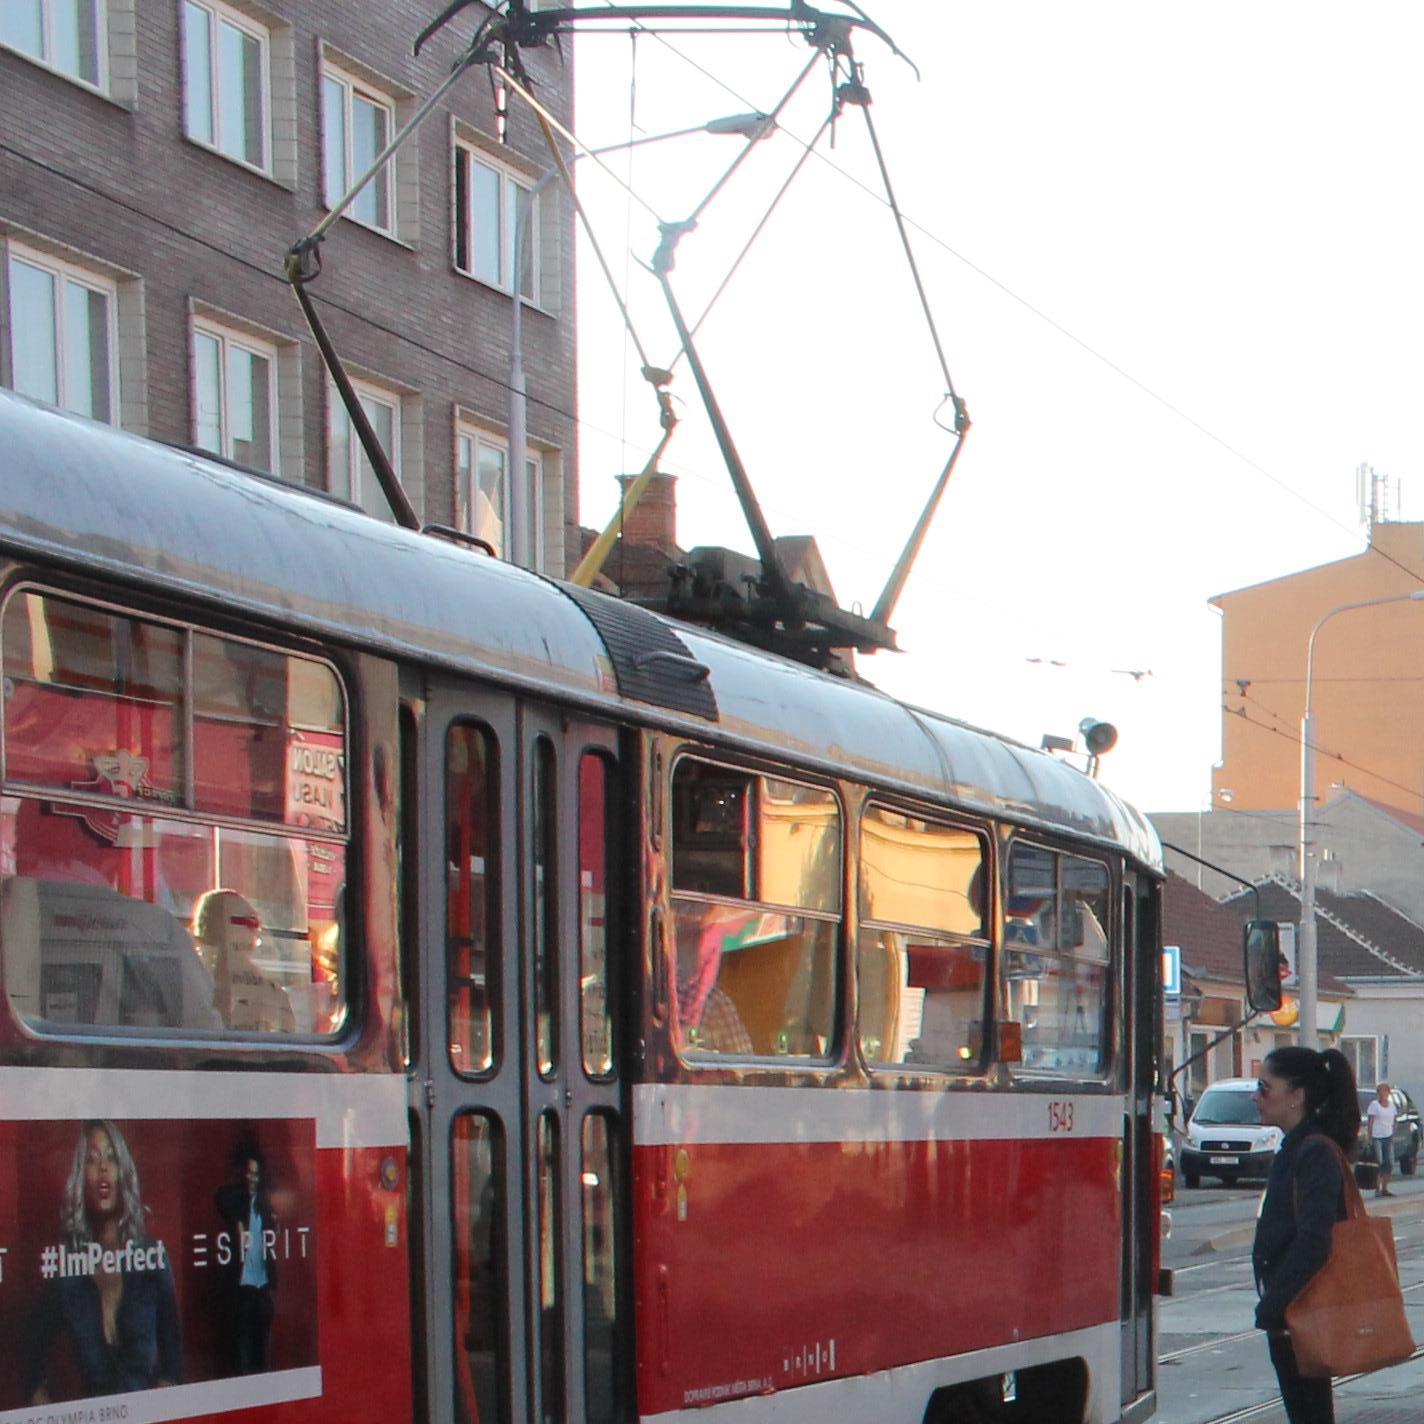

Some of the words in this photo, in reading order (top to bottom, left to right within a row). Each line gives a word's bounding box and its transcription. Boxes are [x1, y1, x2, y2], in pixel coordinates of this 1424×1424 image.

[1048, 1102, 1074, 1131] 1543
[41, 1239, 166, 1280] #ImPerfect
[193, 1227, 310, 1267] ESPRIT
[99, 1404, 129, 1422] BRNO
